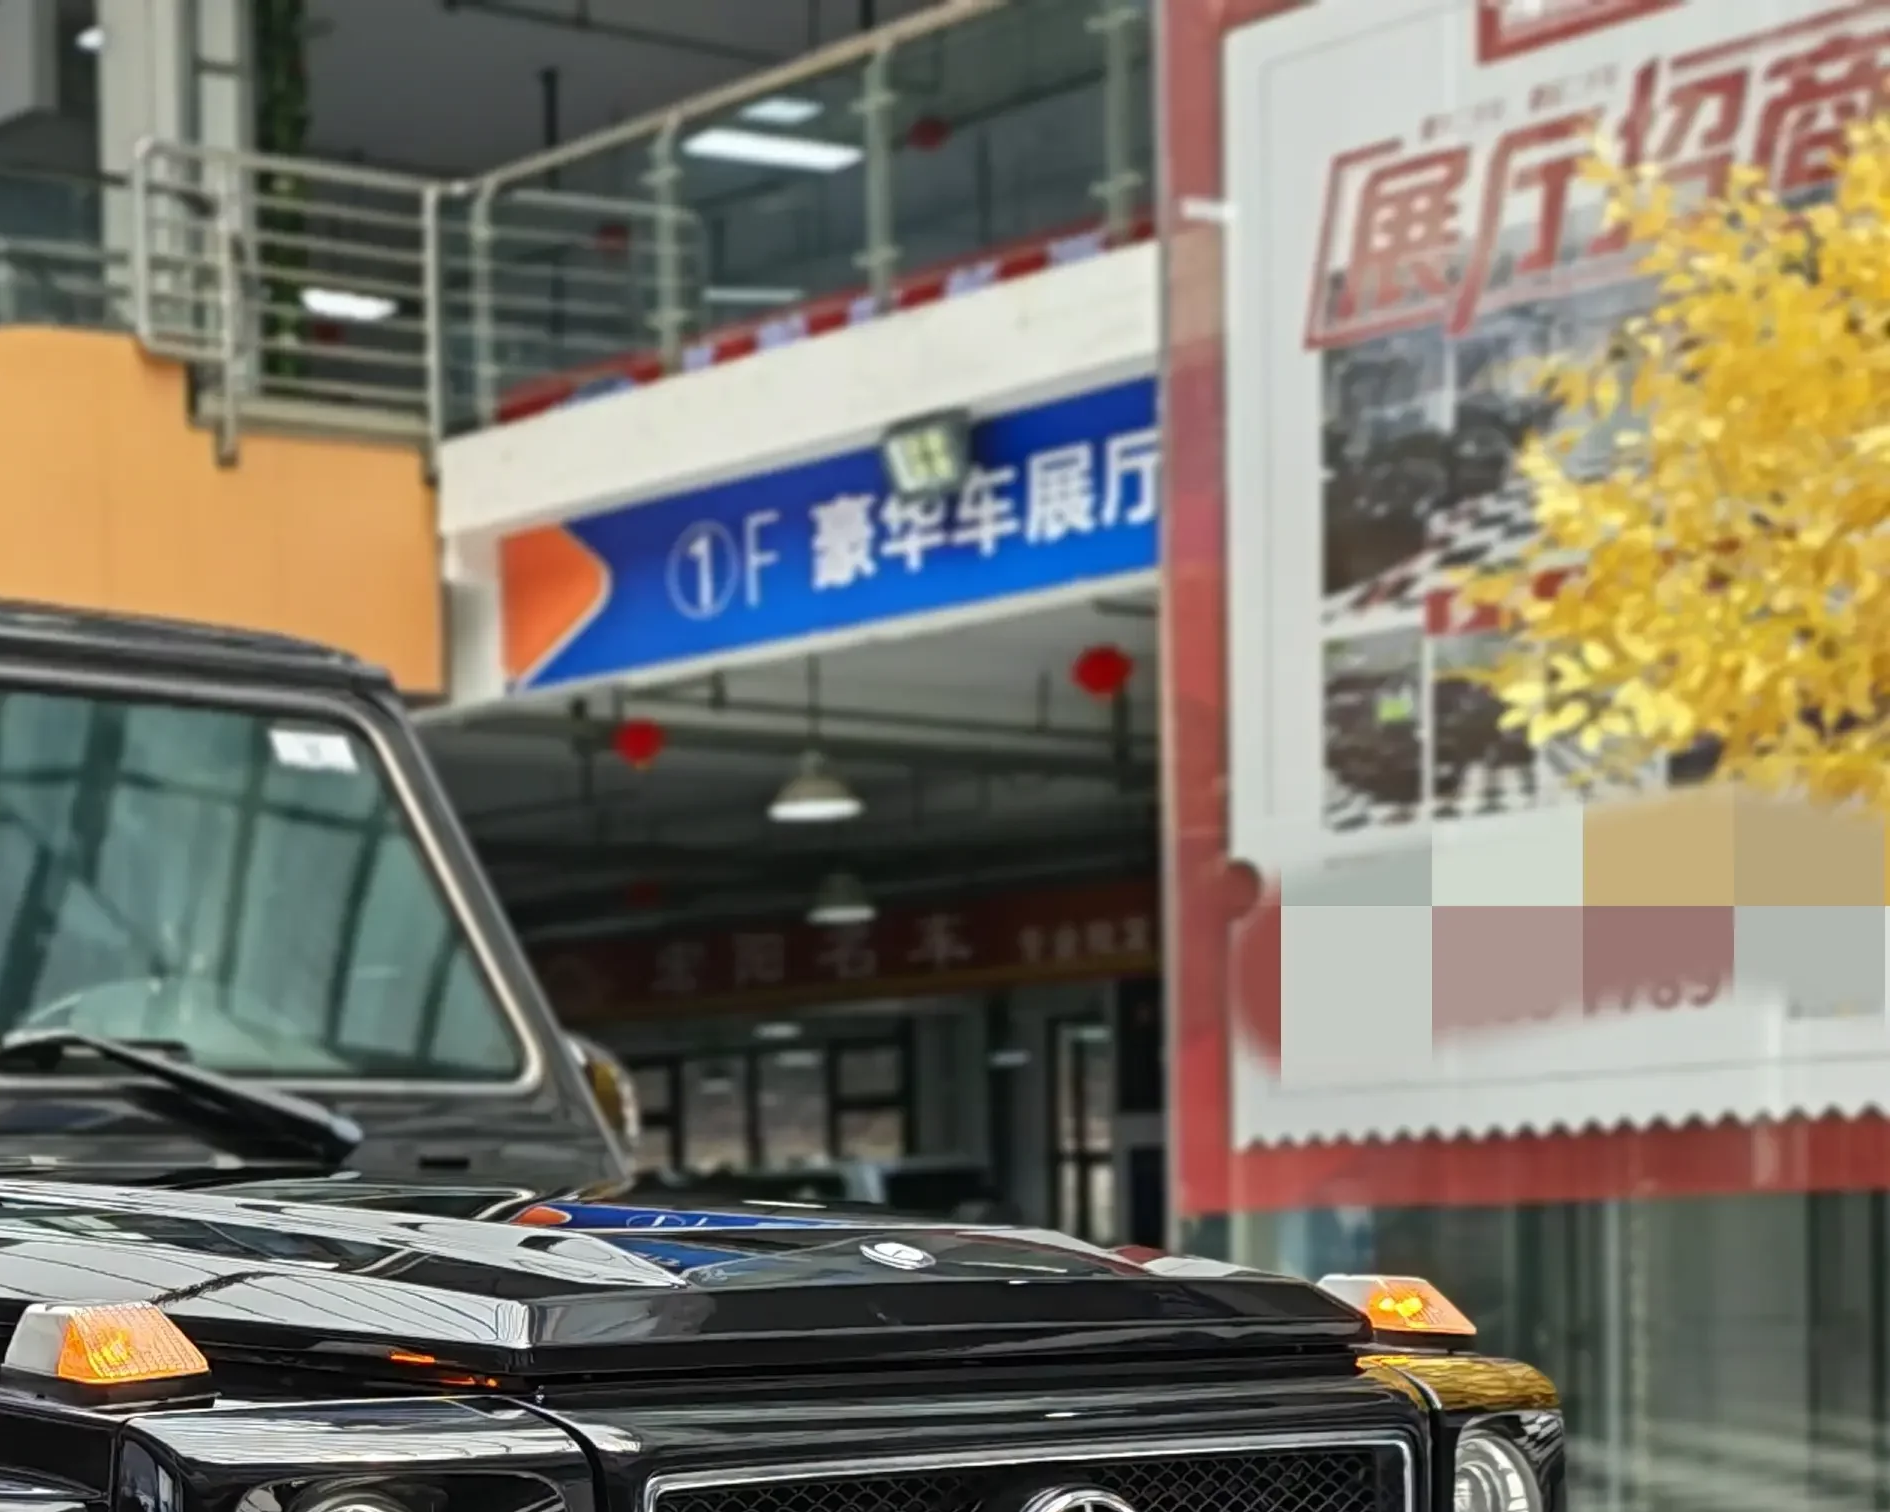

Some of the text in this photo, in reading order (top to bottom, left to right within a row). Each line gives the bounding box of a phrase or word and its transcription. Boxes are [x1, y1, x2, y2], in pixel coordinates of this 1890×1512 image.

[807, 431, 1161, 594] 豪华车展厅
